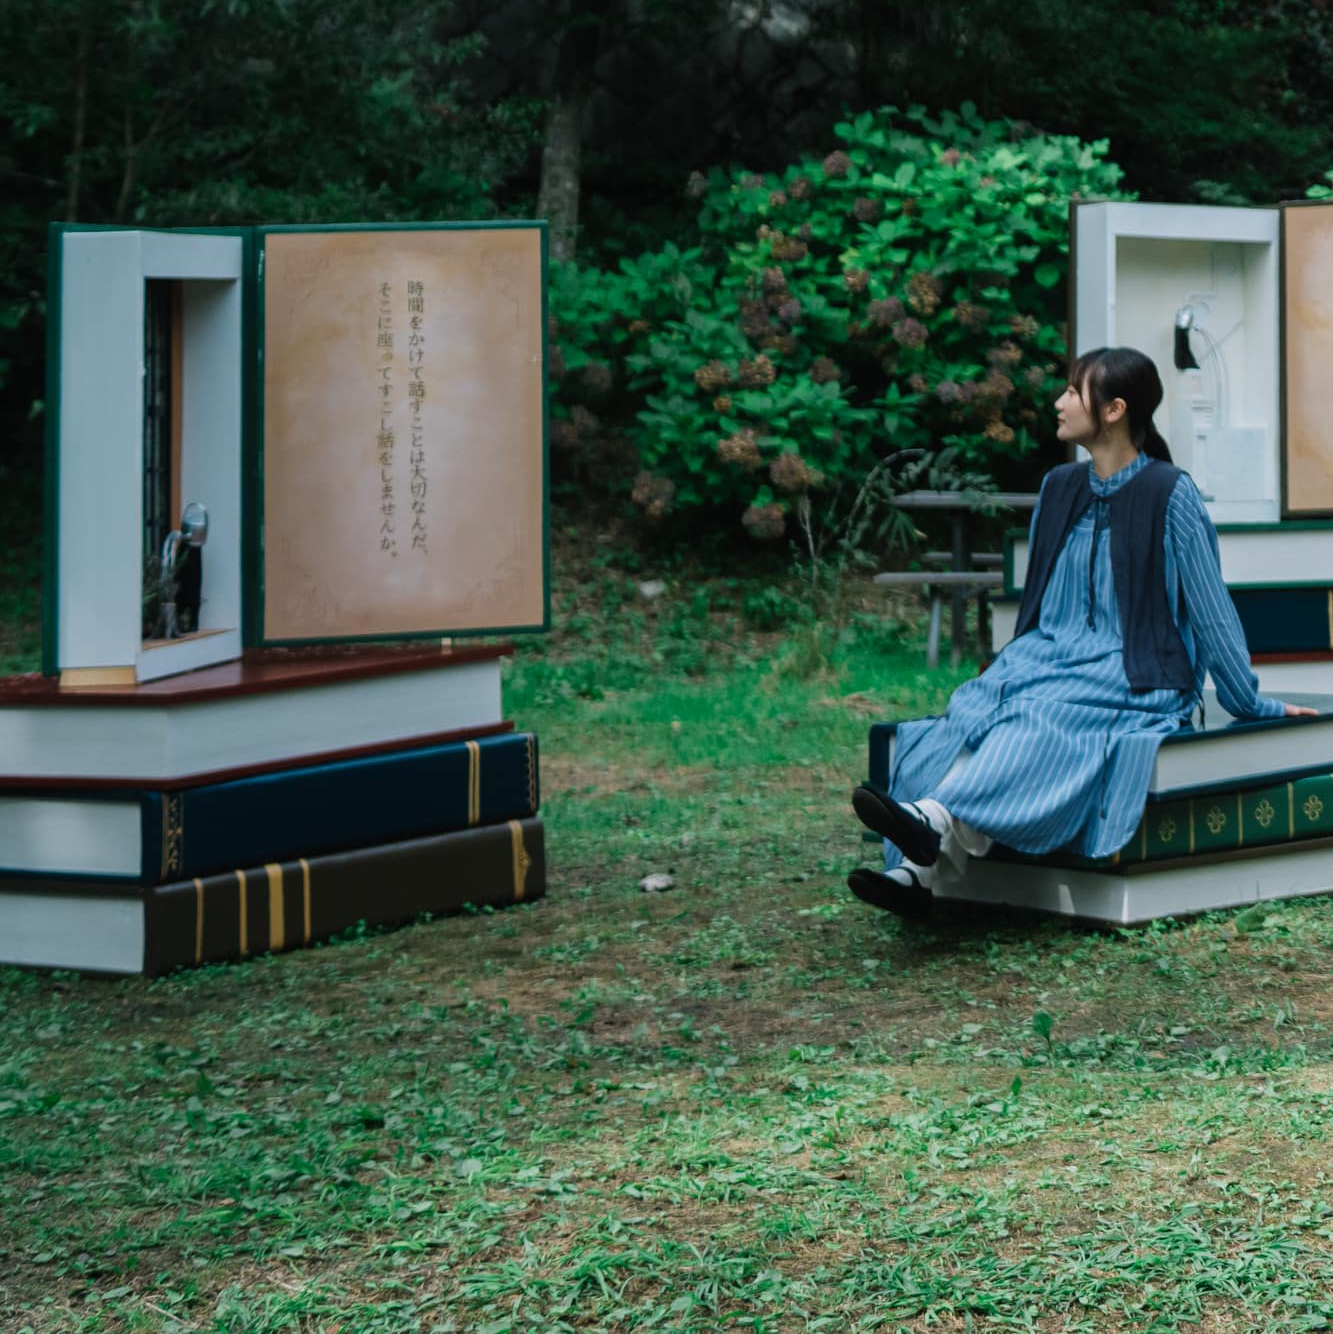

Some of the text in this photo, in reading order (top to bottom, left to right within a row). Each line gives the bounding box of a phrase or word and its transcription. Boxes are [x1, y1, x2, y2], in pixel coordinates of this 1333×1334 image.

[375, 281, 398, 559] そこに座ってすこし話をしませんか。
